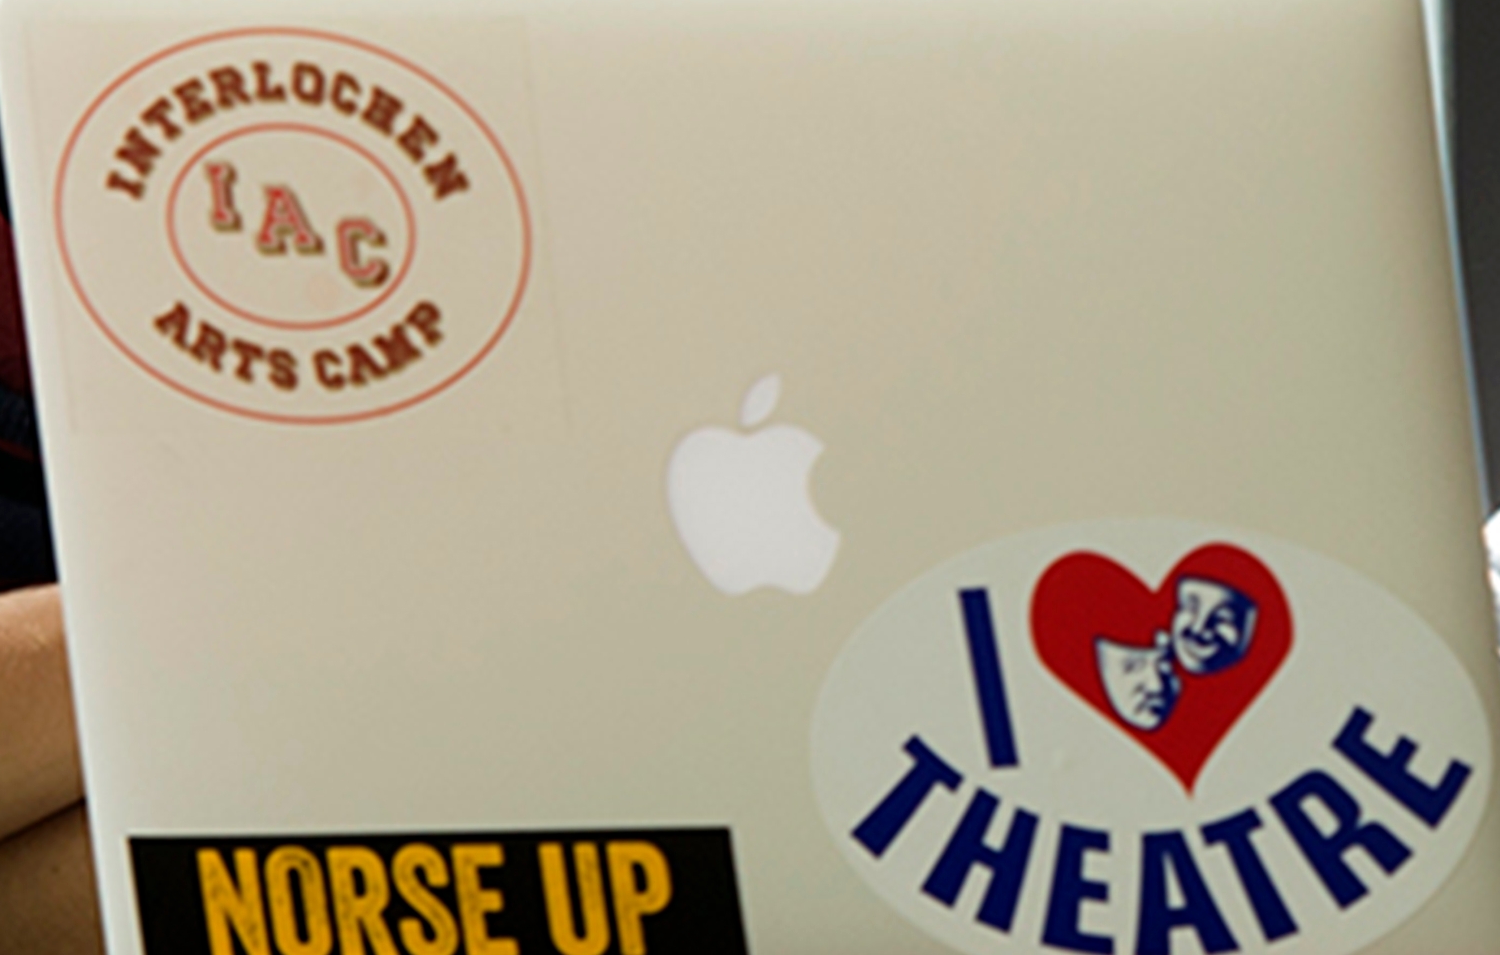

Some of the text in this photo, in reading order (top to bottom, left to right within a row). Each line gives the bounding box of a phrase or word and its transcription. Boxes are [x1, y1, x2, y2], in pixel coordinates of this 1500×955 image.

[106, 60, 470, 202] INTERLOCHEN
[153, 300, 445, 391] ARTS CAMP
[956, 586, 1020, 770] I
[197, 841, 673, 955] NORSE UP
[850, 705, 1473, 955] THEATRE
